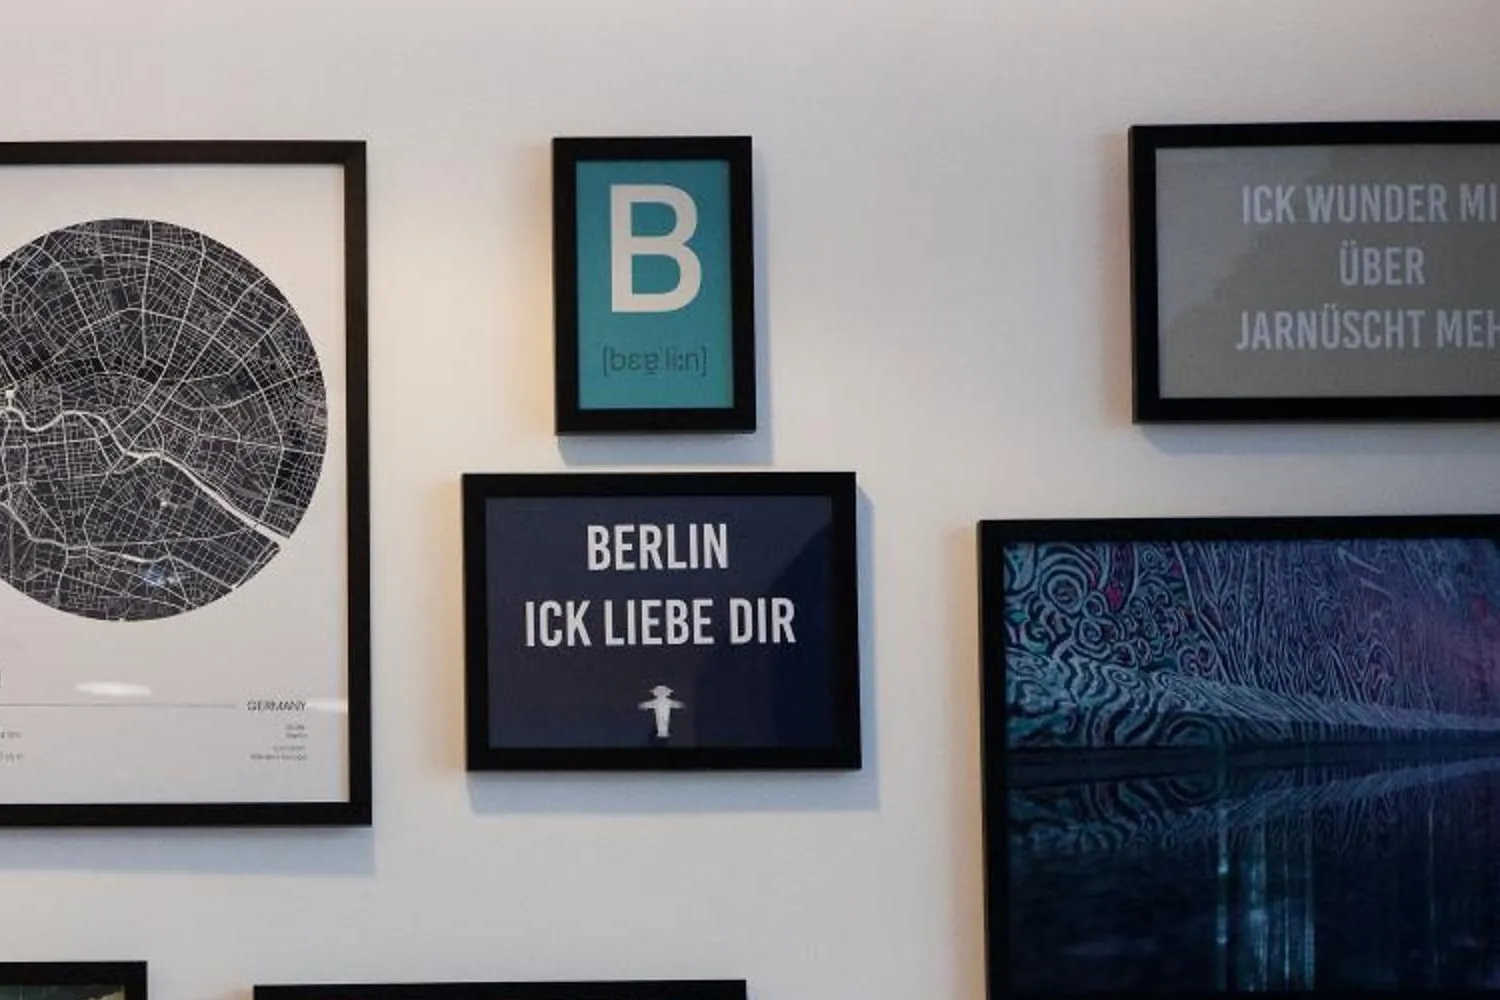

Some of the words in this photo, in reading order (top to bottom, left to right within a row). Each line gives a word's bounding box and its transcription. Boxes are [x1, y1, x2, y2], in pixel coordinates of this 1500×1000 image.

[1242, 184, 1296, 224] ICK
[1305, 182, 1449, 224] WUNDER
[1459, 183, 1498, 222] MI
[610, 183, 702, 313] B
[1339, 240, 1426, 286] ÜBER
[1235, 303, 1426, 351] JARNÜSCHT
[1436, 309, 1500, 349] MEH
[587, 523, 729, 571] BERLIN
[525, 600, 592, 647] ICK
[604, 599, 715, 646] LIEBE
[729, 597, 797, 645] DIR
